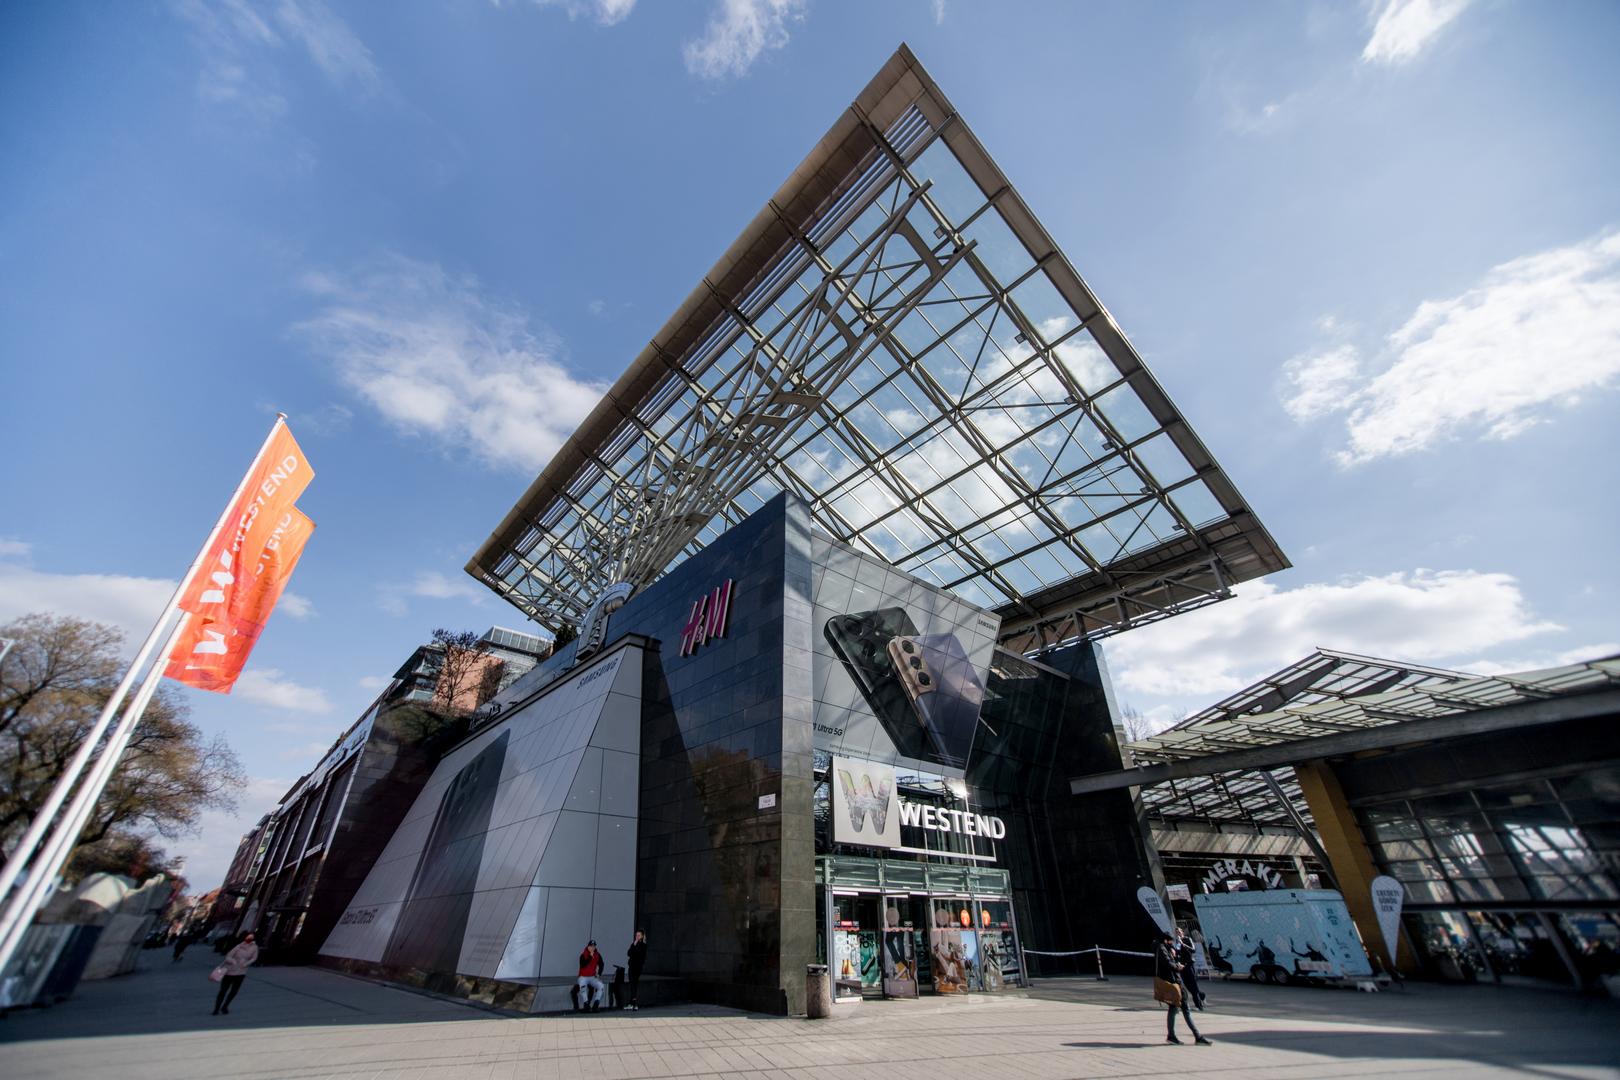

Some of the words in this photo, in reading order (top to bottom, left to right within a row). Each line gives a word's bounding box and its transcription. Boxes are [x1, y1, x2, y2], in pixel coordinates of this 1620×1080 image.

[680, 578, 732, 656] H&M
[817, 724, 834, 734] Ultra
[833, 727, 843, 736] 5G
[898, 799, 1006, 840] WESTEND
[1202, 858, 1282, 892] MERAKI
